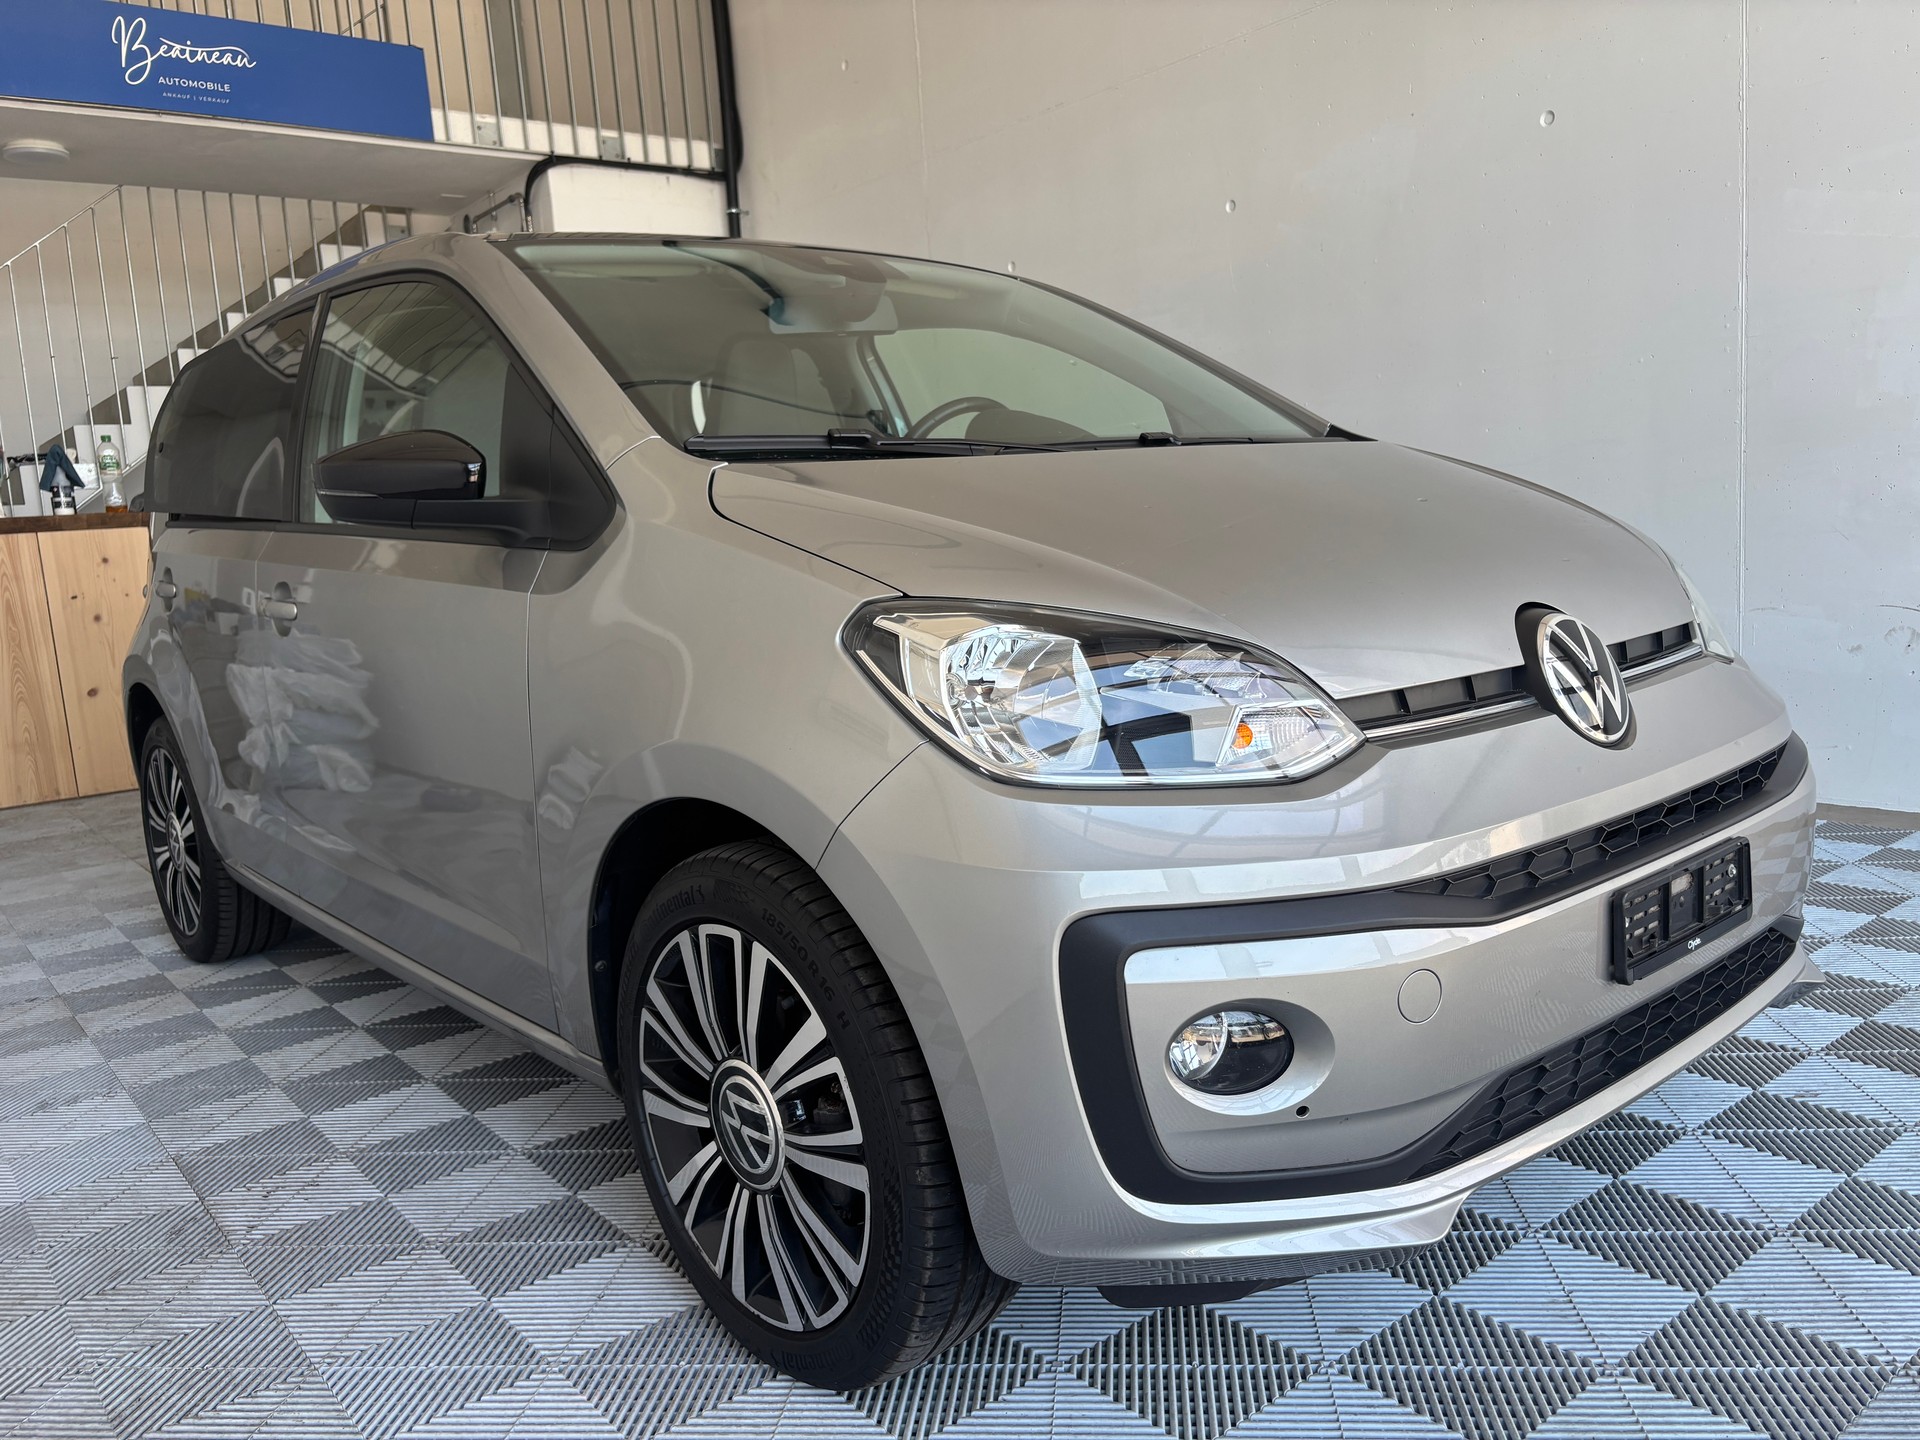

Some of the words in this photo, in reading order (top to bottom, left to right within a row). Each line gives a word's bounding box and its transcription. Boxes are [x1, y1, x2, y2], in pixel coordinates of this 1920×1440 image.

[158, 75, 231, 93] AUTOMOBILE
[162, 91, 191, 101] ANKAUF
[198, 96, 230, 105] VERKAUF
[760, 907, 809, 962] 185/50
[807, 959, 820, 979] R
[818, 976, 836, 1002] 16
